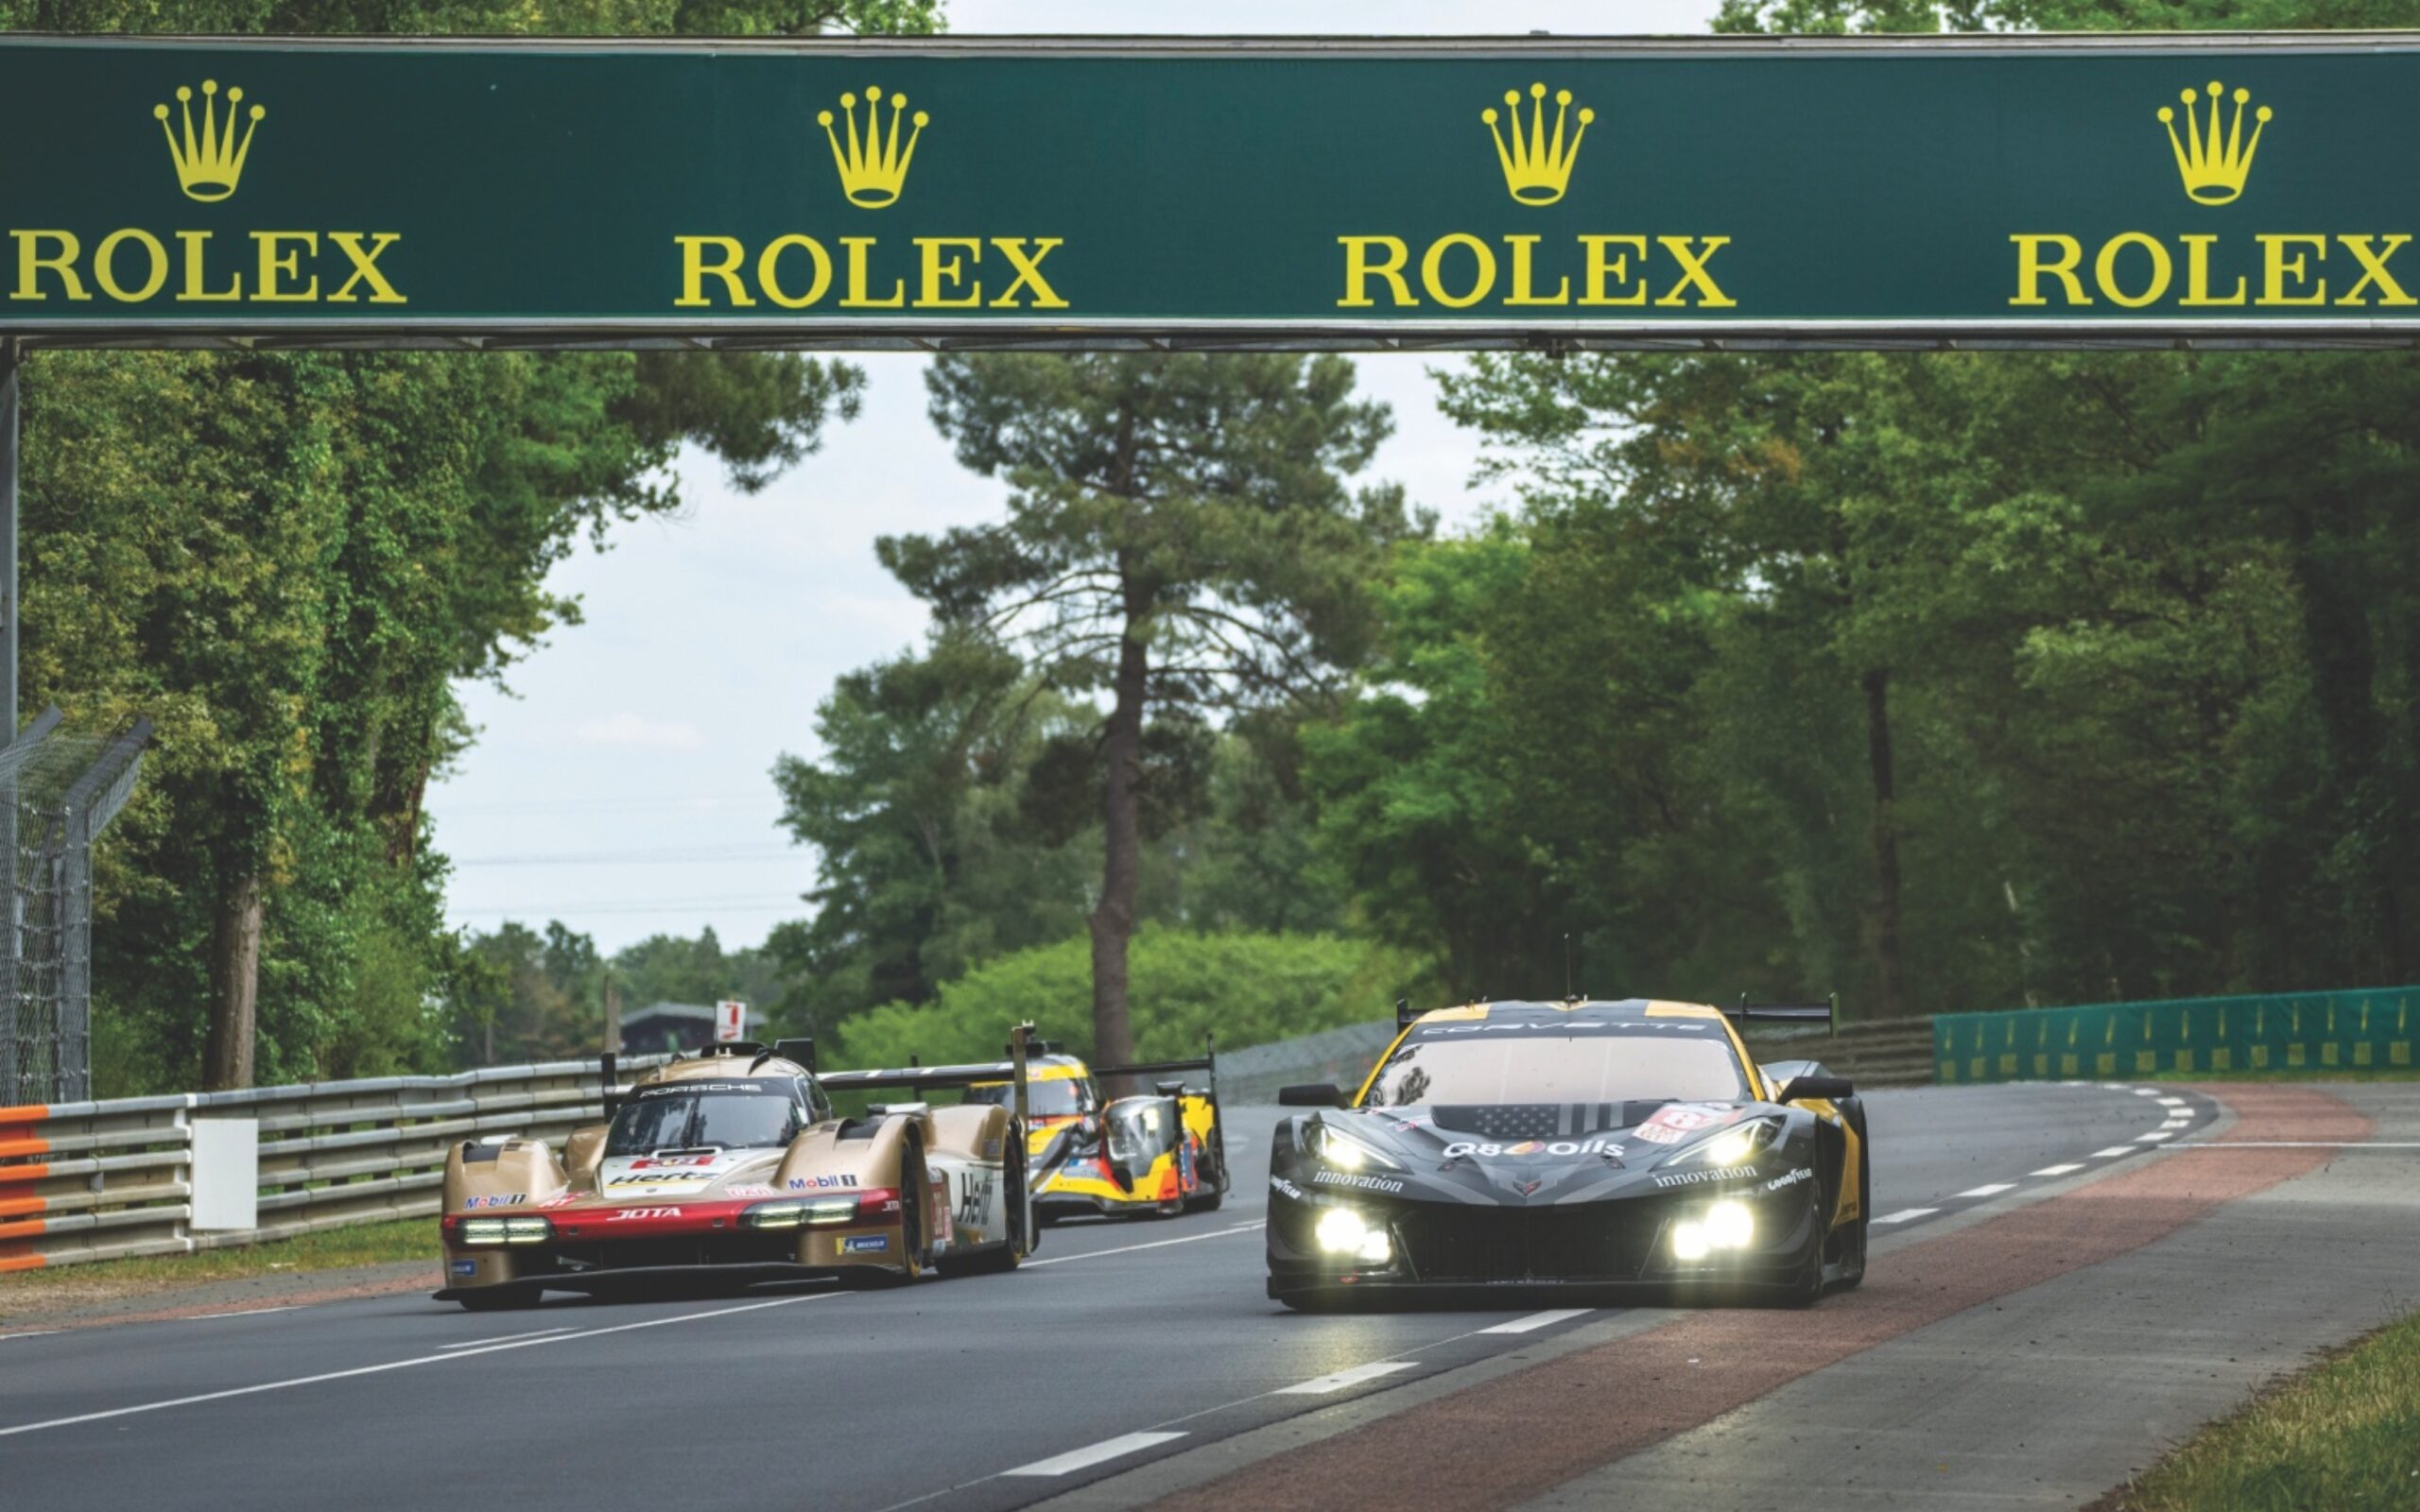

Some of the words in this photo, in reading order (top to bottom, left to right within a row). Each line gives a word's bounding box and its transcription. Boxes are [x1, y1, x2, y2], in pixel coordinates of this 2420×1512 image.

[9, 229, 407, 302] ROLEX
[674, 233, 1069, 308] ROLEX
[1337, 232, 1737, 309] ROLEX
[2009, 232, 2418, 308] ROLEX
[1422, 1022, 1707, 1036] CORVETTE
[639, 1083, 762, 1098] PORSCHE
[1443, 1142, 1501, 1158] Q8
[1547, 1140, 1626, 1157] Oils
[609, 1171, 721, 1186] Hertz
[788, 1176, 838, 1190] Mobil
[840, 1175, 857, 1187] 1
[1313, 1166, 1403, 1193] innovation
[1654, 1163, 1757, 1189] innovation
[464, 1195, 508, 1210] Mobil
[605, 1208, 682, 1221] JOTA
